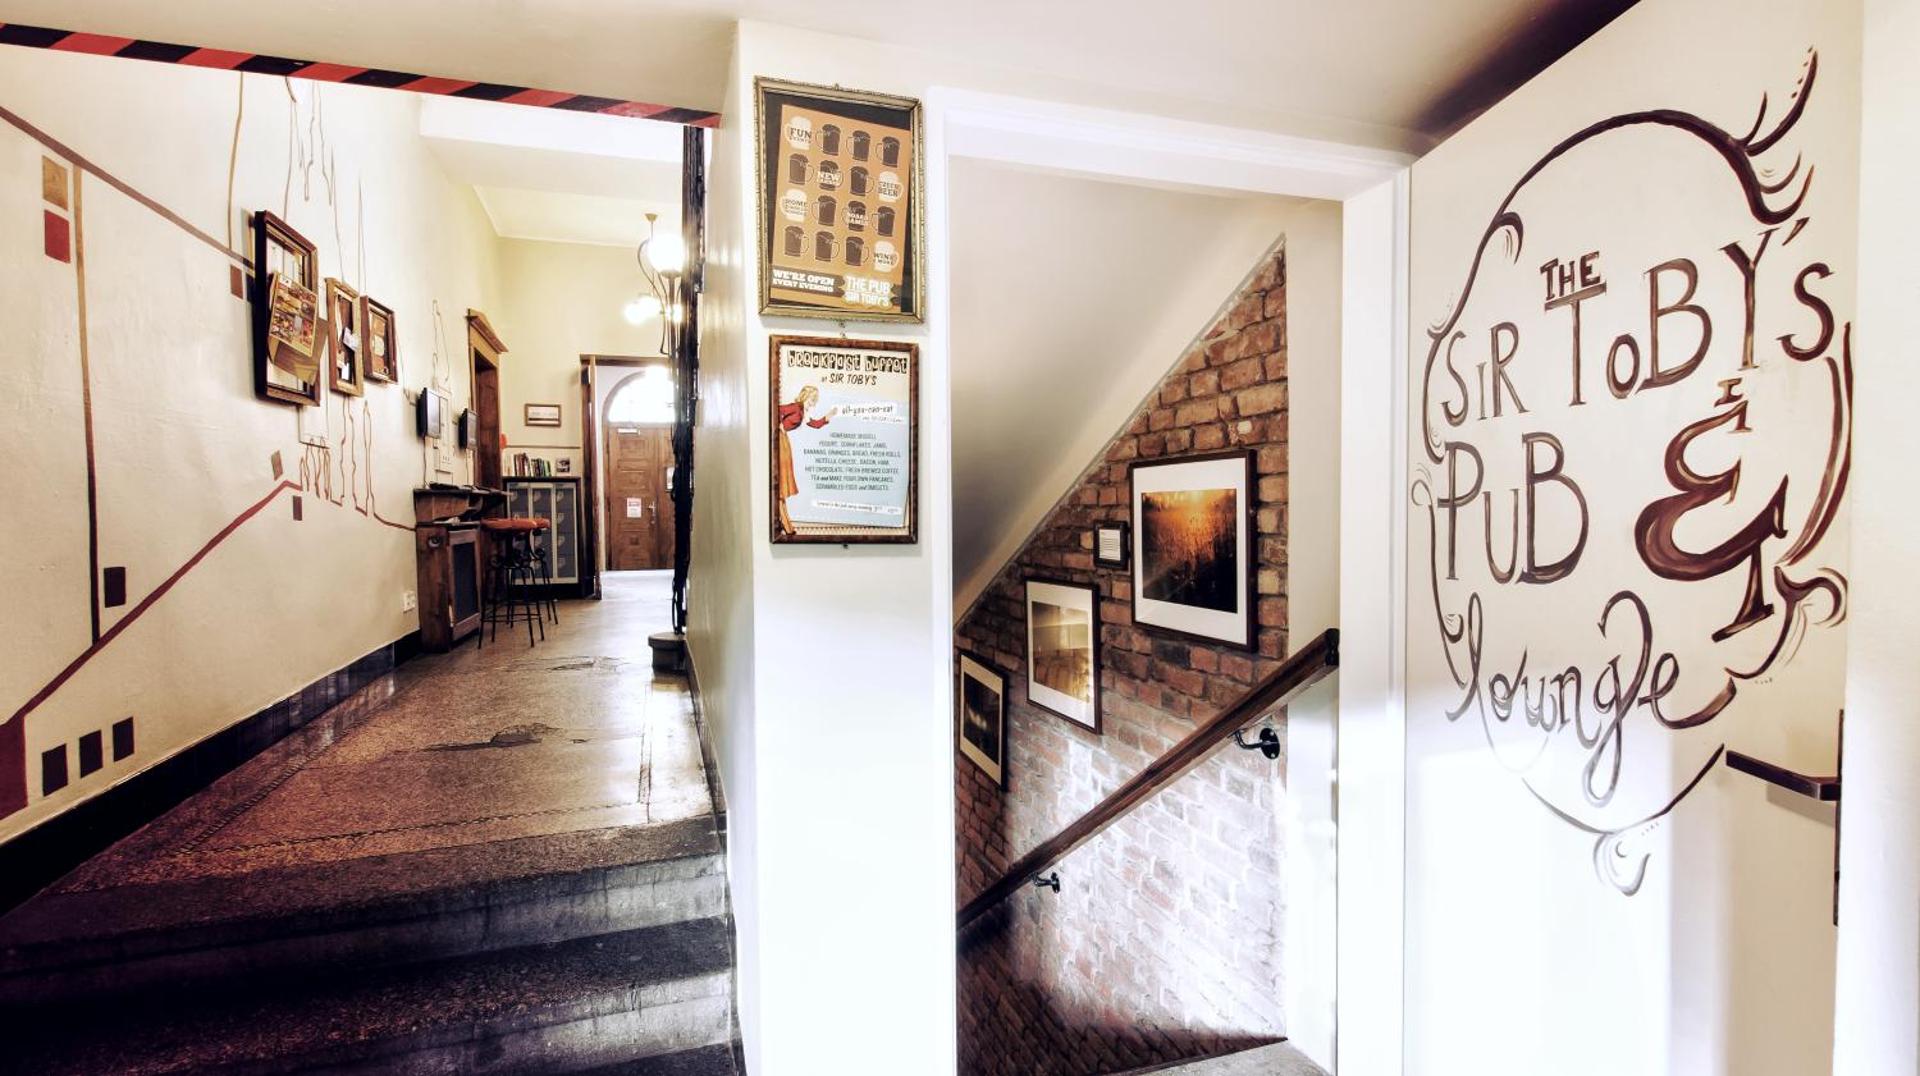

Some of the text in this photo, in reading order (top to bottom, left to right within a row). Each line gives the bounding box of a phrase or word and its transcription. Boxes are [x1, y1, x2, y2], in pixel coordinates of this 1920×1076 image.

[790, 127, 812, 139] FUN
[807, 274, 835, 286] OPEN
[1539, 251, 1601, 301] THE
[846, 275, 891, 293] THE PUB
[829, 373, 845, 384] SIR
[847, 374, 878, 386] TOBY'S
